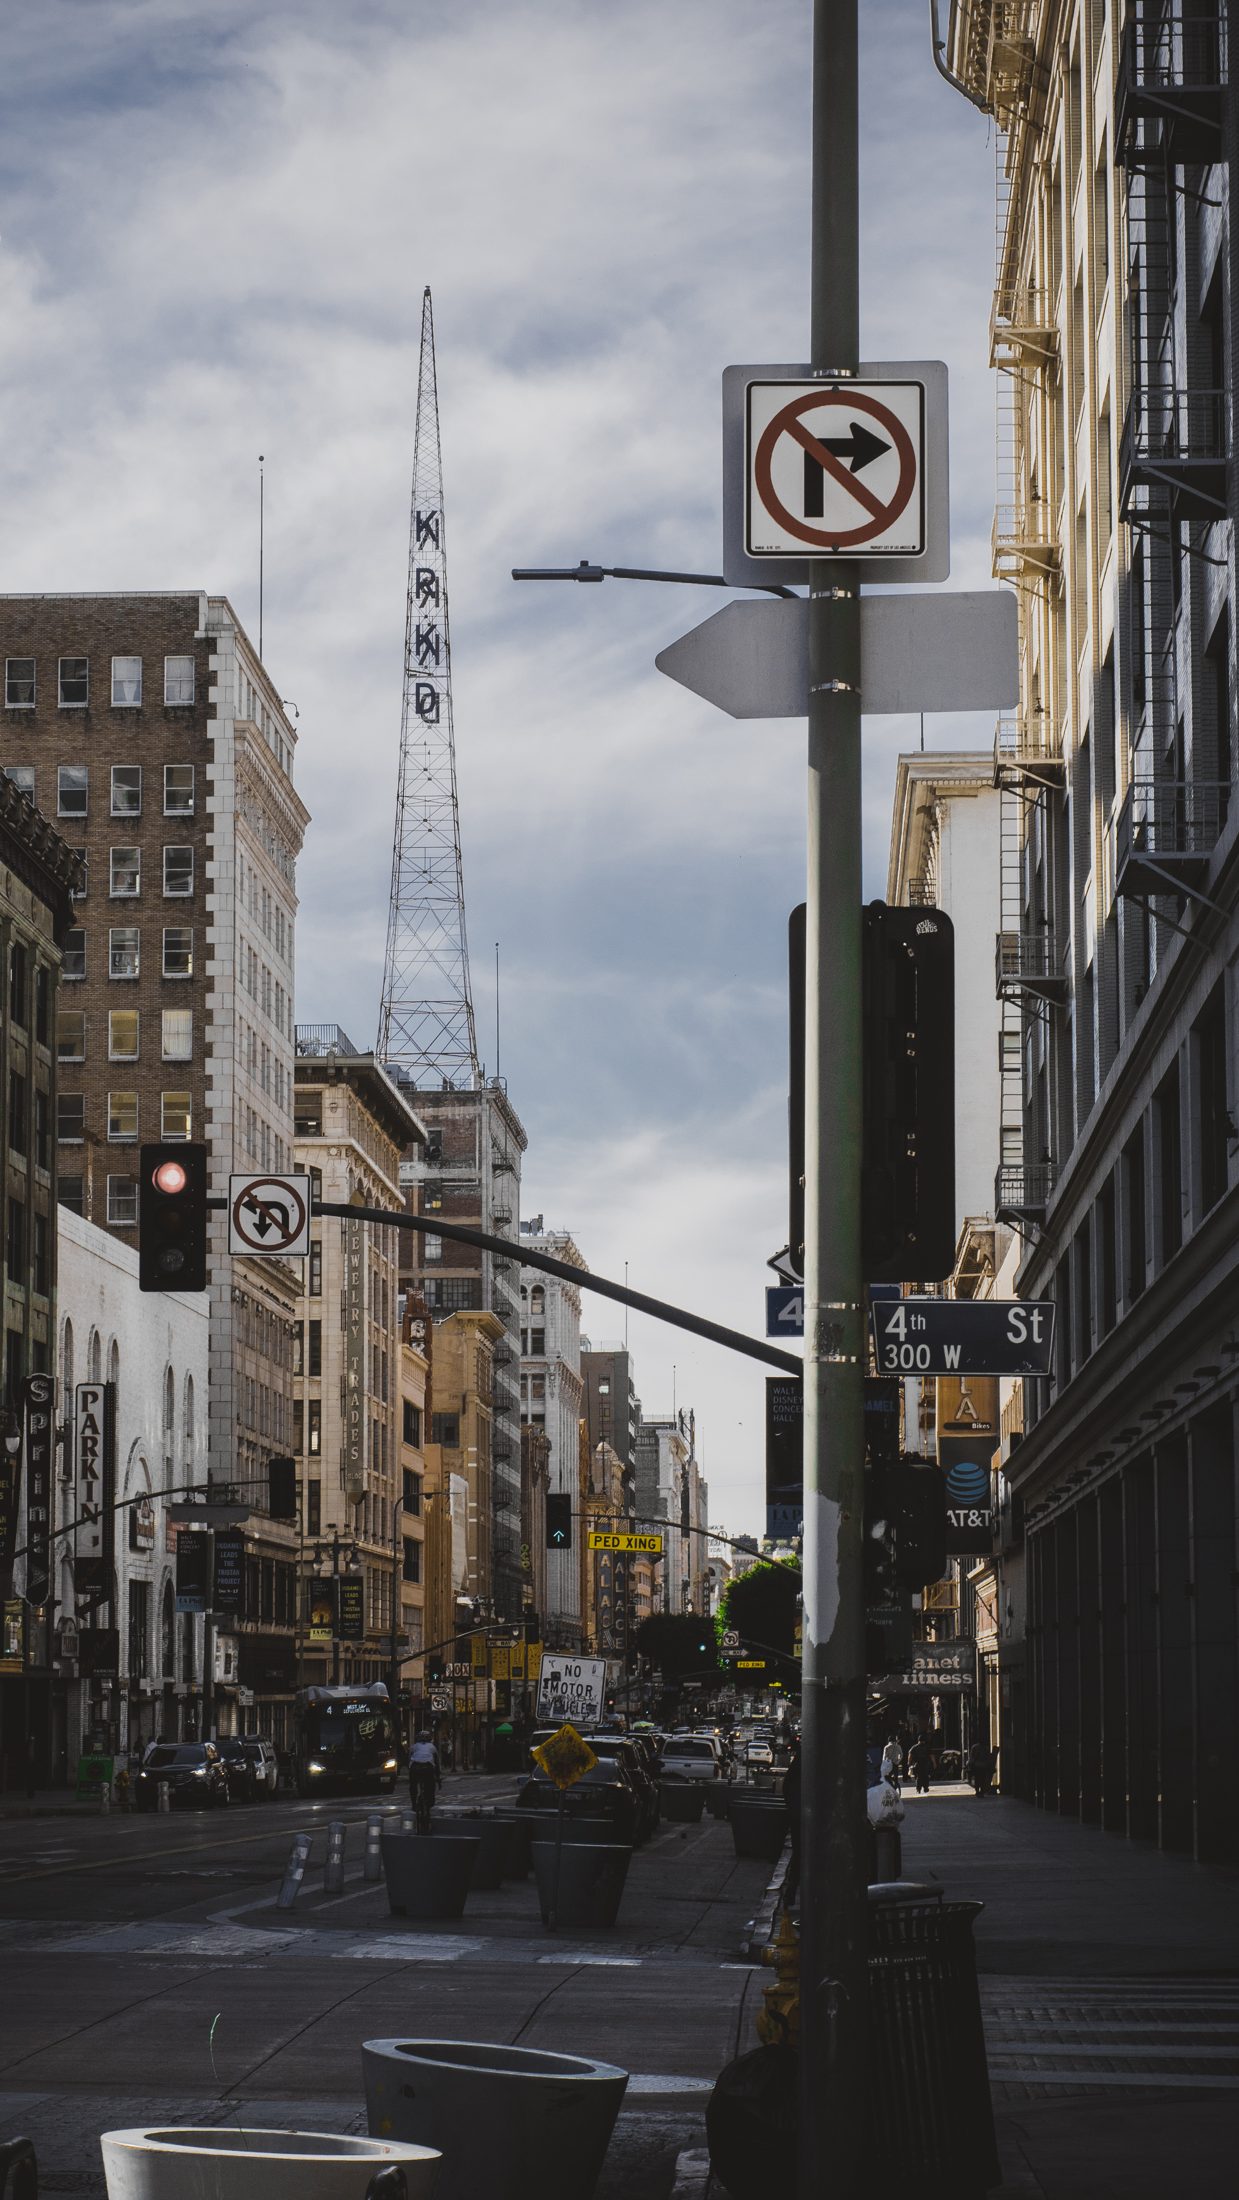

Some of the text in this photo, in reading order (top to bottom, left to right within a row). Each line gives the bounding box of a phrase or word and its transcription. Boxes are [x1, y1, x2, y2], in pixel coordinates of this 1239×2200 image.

[350, 1218, 361, 1339] JEWELRY
[884, 1306, 1044, 1344] 4th St
[884, 1344, 961, 1369] 300 W
[773, 1387, 795, 1395] WALT
[350, 1356, 360, 1460] TRADES
[773, 1405, 803, 1413] CONCE
[864, 1401, 896, 1412] AMEL
[773, 1414, 794, 1422] HALL
[972, 1422, 990, 1430] Bikes
[947, 1510, 992, 1527] AT&T
[594, 1535, 656, 1550] PED XING
[600, 1554, 611, 1648] ALACE
[615, 1554, 625, 1649] ALACE
[912, 1655, 960, 1669] anet
[564, 1664, 581, 1677] NO
[550, 1681, 593, 1697] MOTOR
[326, 1706, 332, 1715] 4
